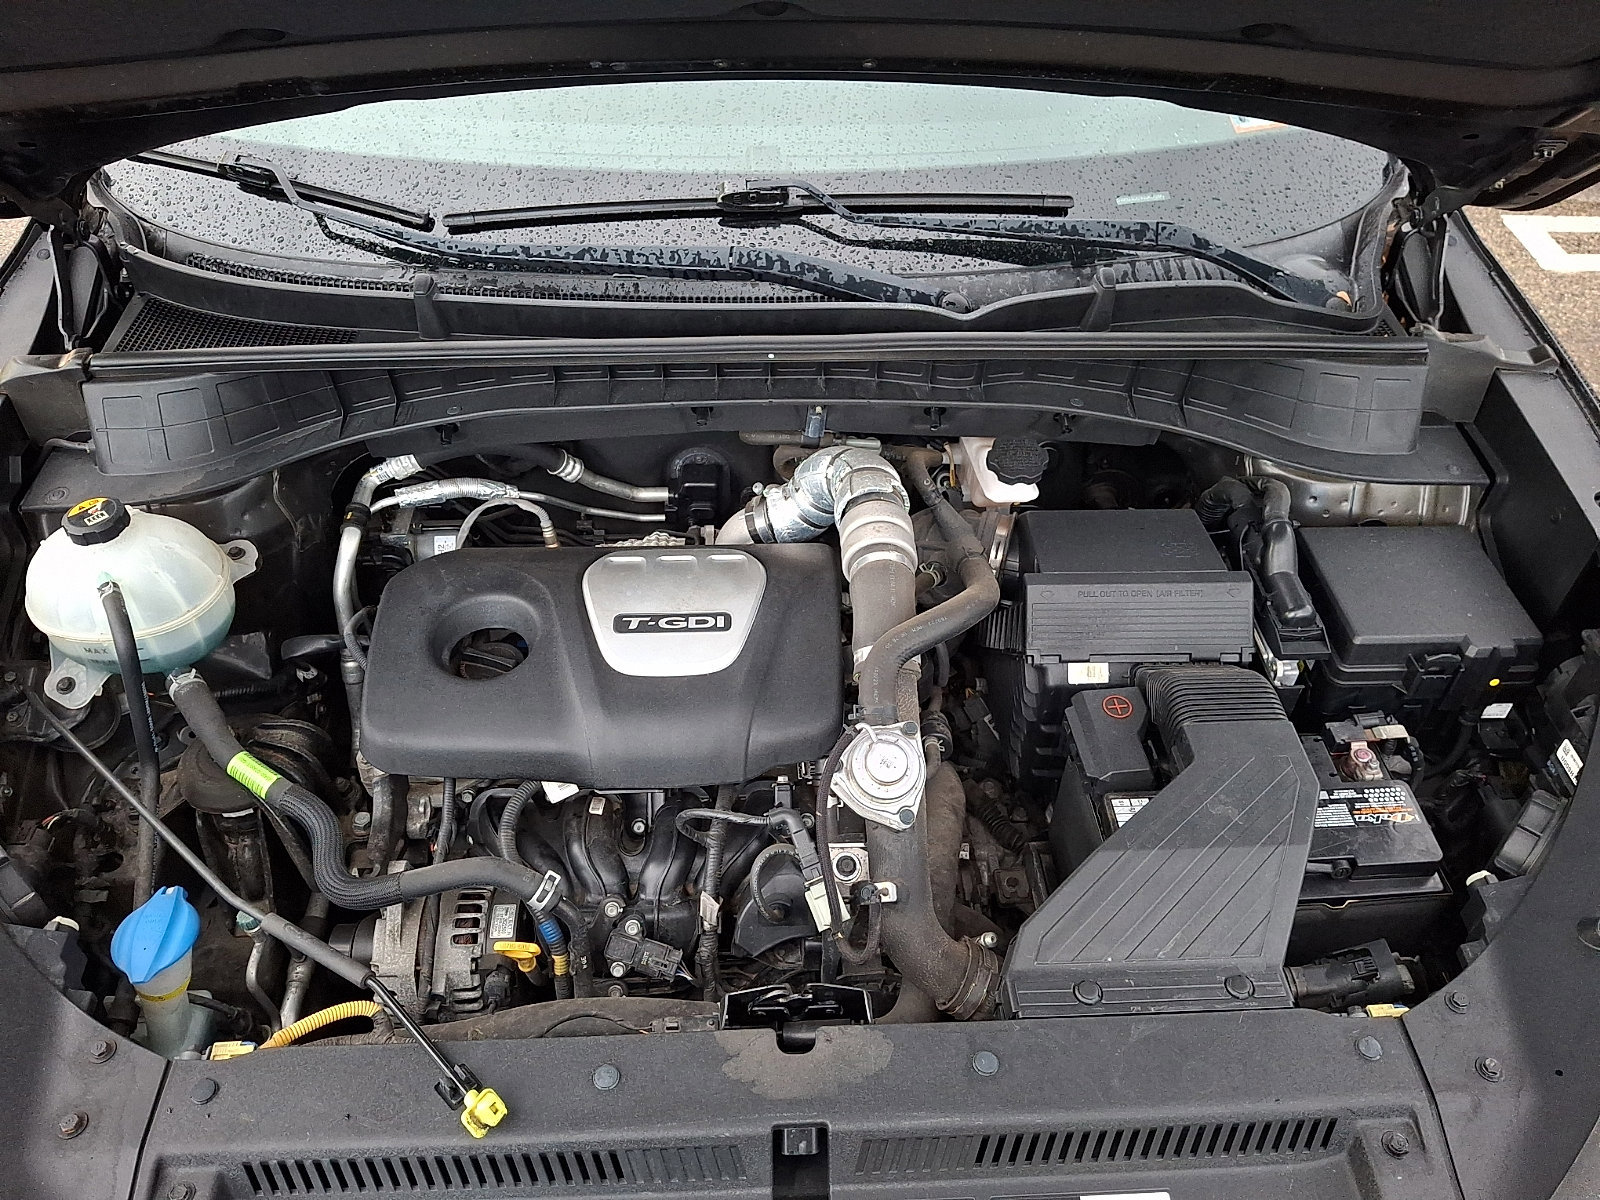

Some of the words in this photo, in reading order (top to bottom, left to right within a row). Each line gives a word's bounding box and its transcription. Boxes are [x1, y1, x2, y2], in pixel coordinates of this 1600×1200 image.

[1078, 590, 1099, 598] PULL
[1100, 590, 1117, 598] OUT
[1118, 589, 1129, 598] TO
[1131, 589, 1153, 598] OPEN
[621, 615, 725, 630] T-GDI
